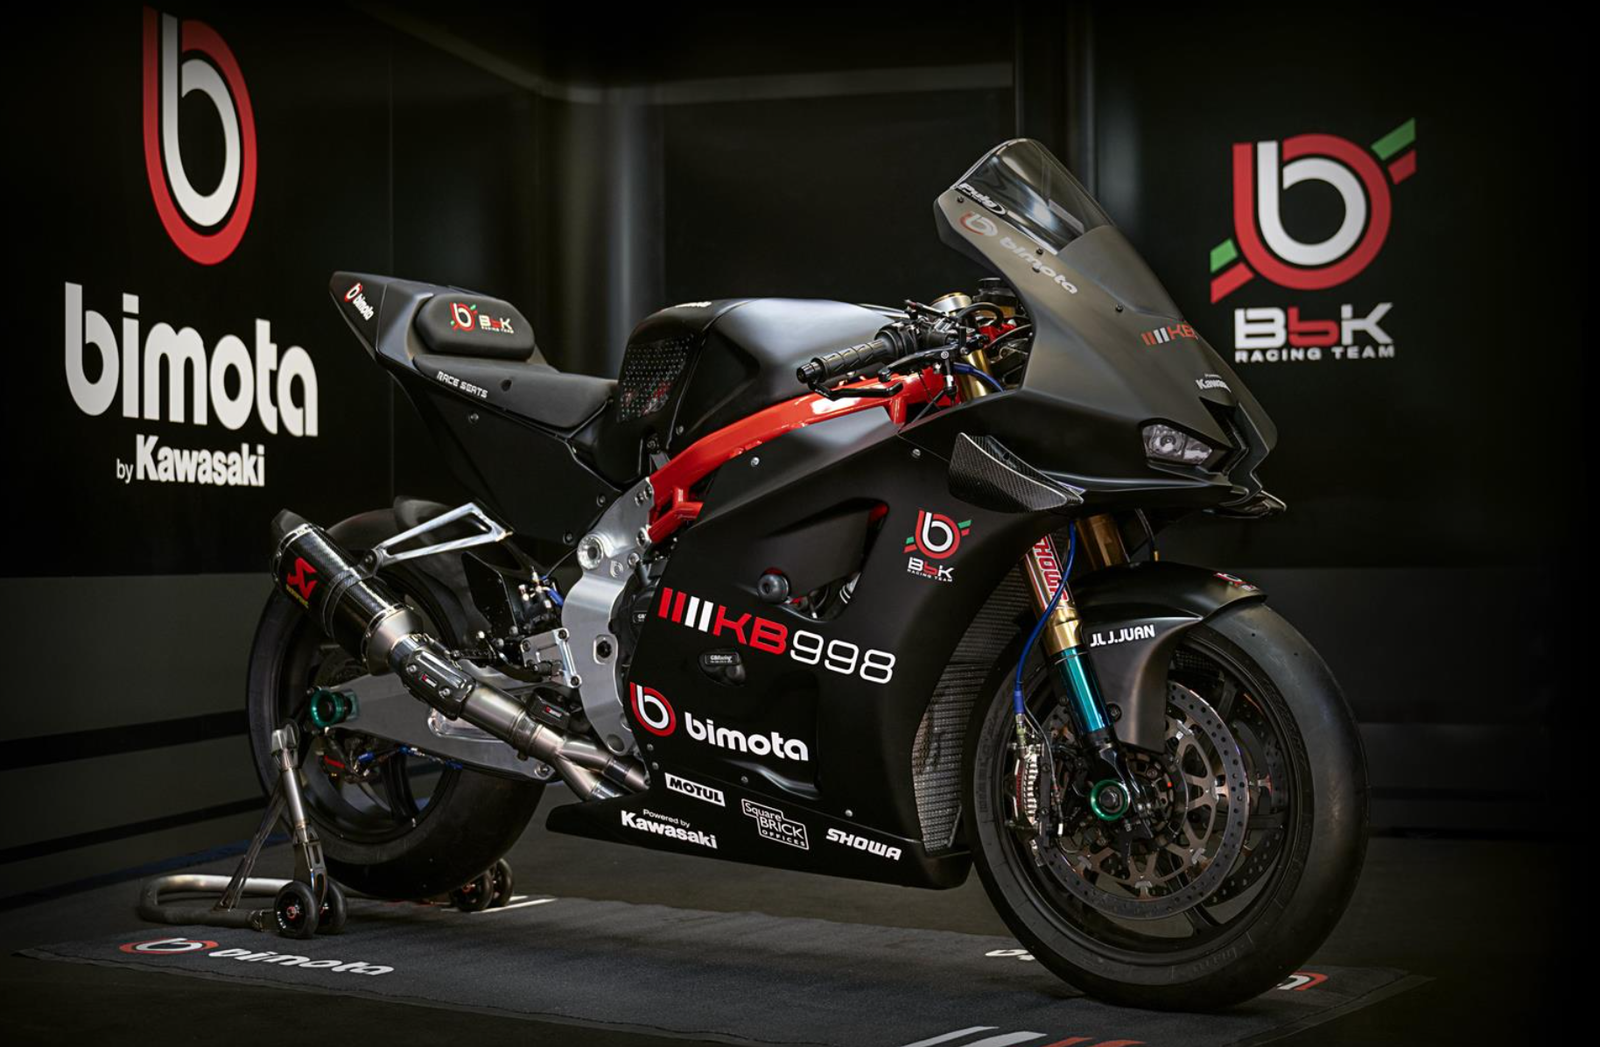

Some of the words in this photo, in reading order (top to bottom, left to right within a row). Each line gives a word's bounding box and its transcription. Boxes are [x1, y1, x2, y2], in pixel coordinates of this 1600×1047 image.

[1000, 237, 1077, 294] bimota
[65, 282, 318, 437] bimota
[1235, 347, 1321, 363] RACING
[1332, 345, 1395, 360] TEAM
[436, 370, 459, 387] RACE
[460, 381, 488, 399] SEATS
[116, 458, 134, 483] by
[136, 434, 265, 487] Kawasaki
[713, 604, 896, 684] KB998
[684, 711, 809, 761] bimota
[669, 777, 723, 803] MOTUL
[642, 808, 680, 825] Powered
[680, 818, 691, 828] by
[744, 802, 782, 821] Square
[620, 810, 718, 849] Kawasaki
[759, 817, 804, 839] BRICK
[762, 829, 806, 847] OFFICES
[826, 828, 902, 860] SHOWA
[209, 948, 394, 976] bimota
